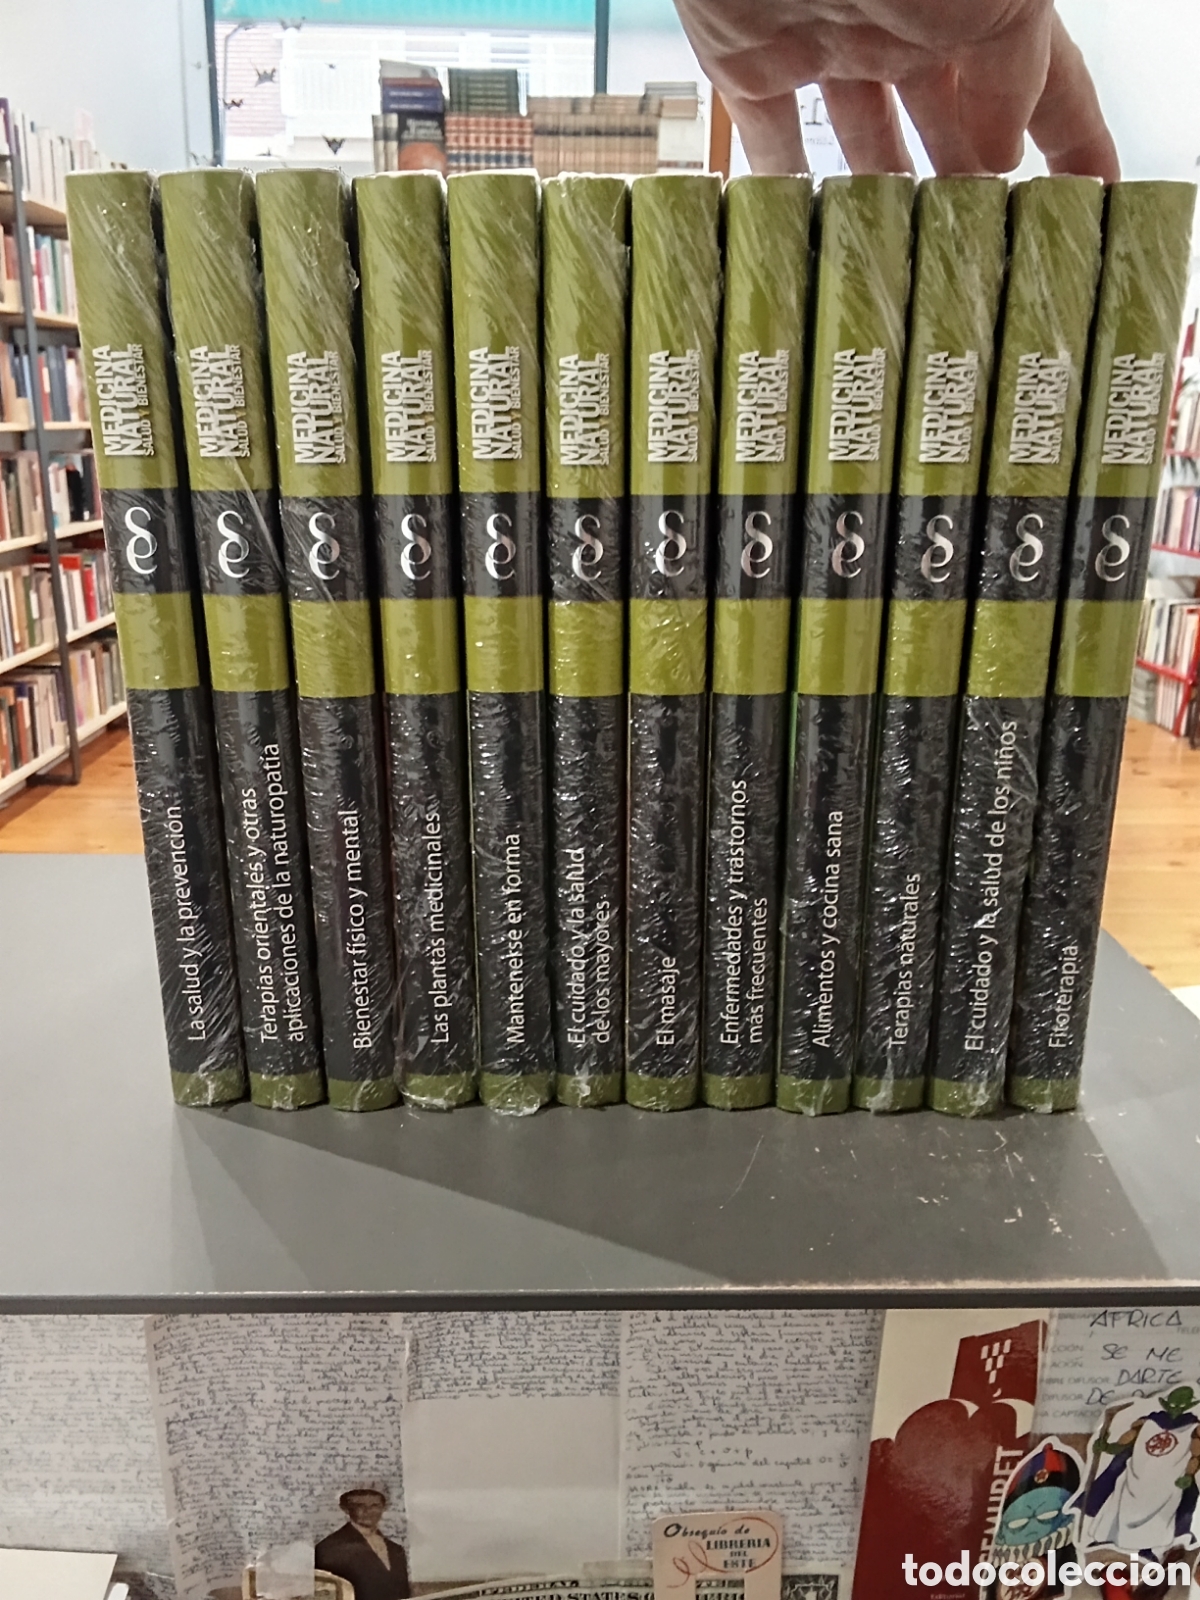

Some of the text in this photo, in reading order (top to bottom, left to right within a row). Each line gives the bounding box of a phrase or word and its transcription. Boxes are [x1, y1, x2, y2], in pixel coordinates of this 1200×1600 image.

[92, 344, 123, 456] MEDICINA
[110, 343, 146, 456] NATURAL
[133, 343, 149, 407] BIENESTAR
[189, 345, 219, 457] MEDICINA
[208, 344, 241, 457] NATURAL
[230, 344, 246, 408] BIENESTAR
[287, 351, 315, 464] MEDICINA
[306, 350, 338, 464] NATURAL
[381, 350, 406, 462] MEDICINA
[401, 349, 430, 462] NATURAL
[468, 347, 491, 459] MEDICINA
[487, 345, 514, 459] NATURAL
[508, 345, 520, 409] BIENESTAR
[559, 353, 581, 465] MEDICINA
[578, 352, 602, 465] NATURAL
[599, 352, 610, 416] BIENESTAR
[648, 350, 670, 462] MEDICINA
[667, 349, 691, 462] NATURAL
[735, 350, 760, 462] MEDICINA
[756, 349, 781, 462] NATURAL
[828, 348, 855, 461] MEDICINA
[849, 347, 876, 461] NATURAL
[919, 351, 949, 463] MEDICINA
[939, 350, 971, 463] NATURAL
[1008, 352, 1042, 464] MEDICINA
[1030, 351, 1061, 464] NATURAL
[1101, 353, 1136, 464] MEDICINA
[1123, 352, 1158, 464] NATURAL
[139, 419, 155, 456] SALUD
[236, 420, 251, 458] SALUD
[510, 422, 522, 460] SALUD
[598, 428, 610, 466] SALUD
[166, 804, 206, 1041] La salud y la prevención
[242, 787, 281, 1044] Terapias orientales y otras
[263, 742, 305, 1042] aplicaciones de la naturopatía
[338, 808, 373, 1050] Bienestar físico y mental
[422, 811, 453, 1044] Las plantas medicinales
[502, 832, 525, 1045] Mantenerse en forma
[721, 779, 749, 1046] Enfermedades y trastornos
[811, 809, 845, 1049] Alimentos y cocina sana
[964, 719, 1019, 1051] El cuidado y la salud de los niños
[564, 846, 592, 1045] El cuidado y la salud
[591, 899, 615, 1045] de los mayores
[656, 954, 681, 1046] El masaje
[746, 897, 768, 1002] frecuentes
[888, 872, 922, 1049] Terapias naturales
[1049, 945, 1080, 1049] Fitoterapia
[1090, 1308, 1183, 1328] AFRICA
[1101, 1343, 1128, 1360] SE
[1146, 1346, 1183, 1362] ME
[1114, 1368, 1183, 1386] DARTE
[706, 1538, 770, 1550] LIBRERIA
[723, 1559, 757, 1569] ESTE
[734, 1524, 750, 1535] de
